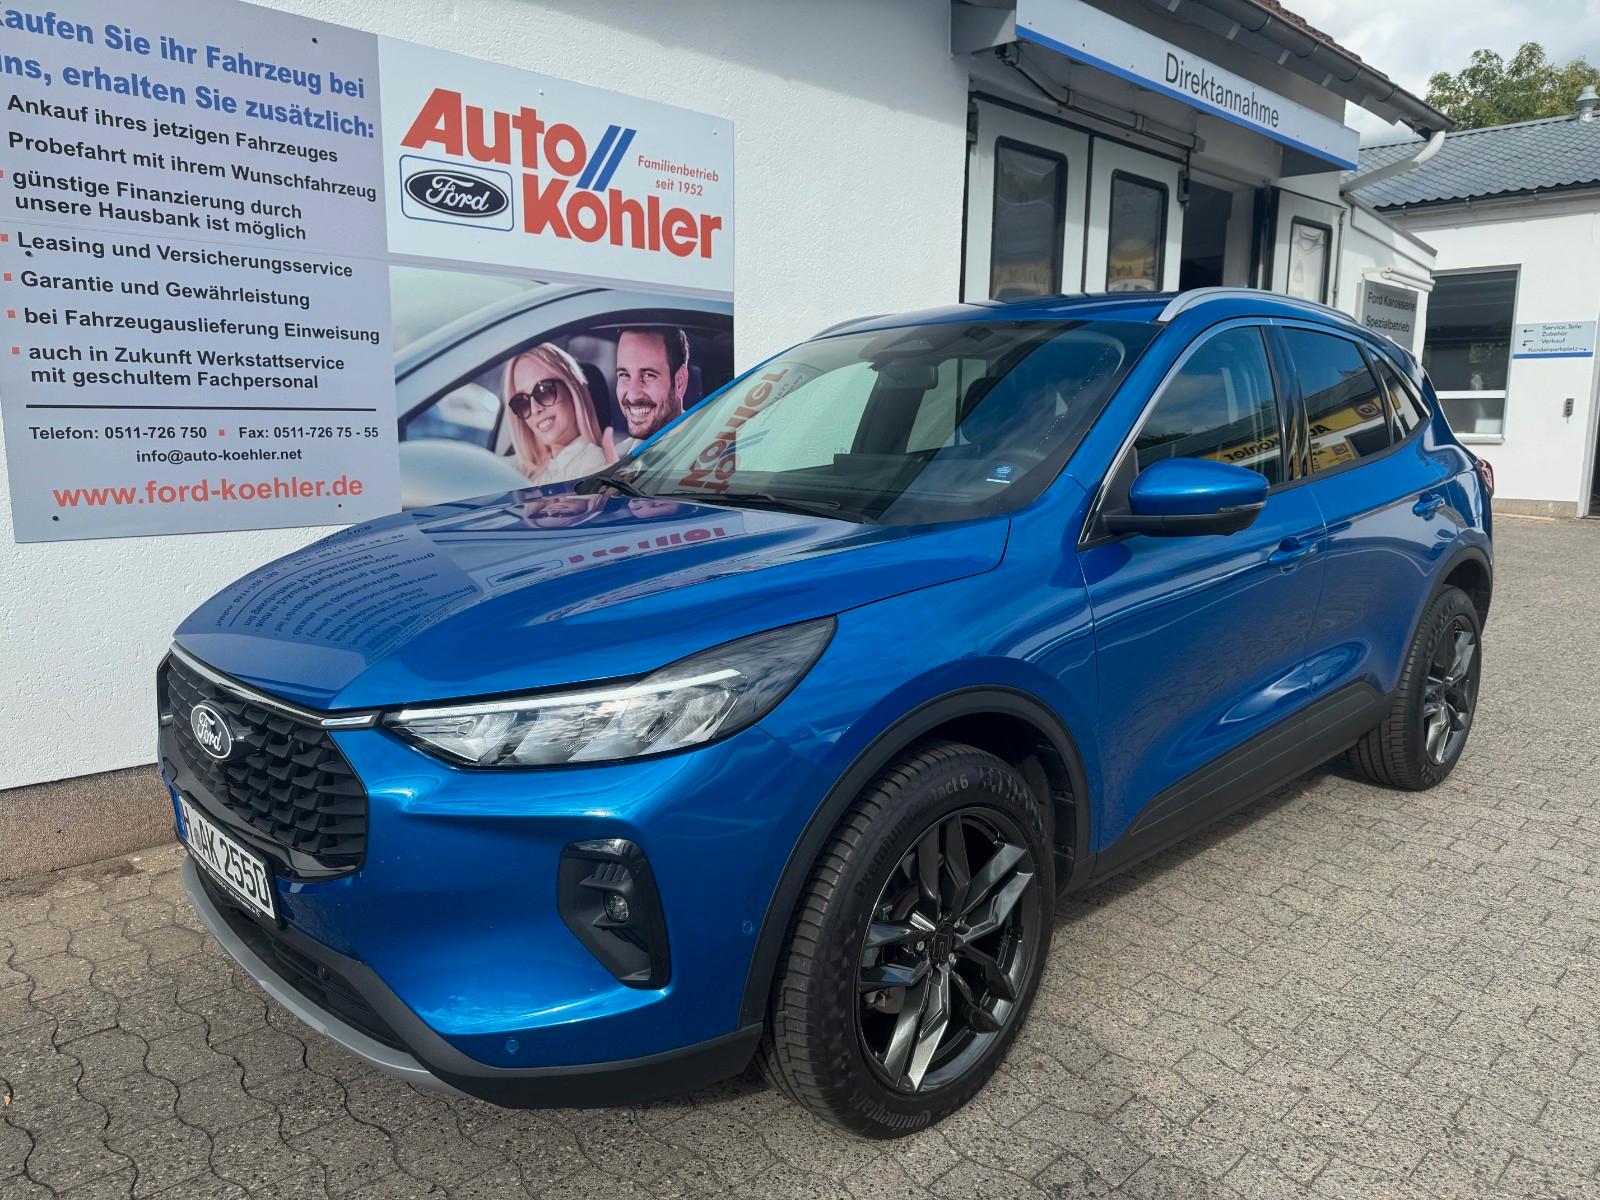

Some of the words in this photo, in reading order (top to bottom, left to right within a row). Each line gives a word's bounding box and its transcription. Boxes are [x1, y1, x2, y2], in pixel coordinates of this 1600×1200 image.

[104, 24, 150, 55] Sie
[160, 36, 197, 65] ihr
[205, 46, 321, 95] Fahrzeug
[330, 71, 364, 98] bei
[62, 66, 186, 105] erhalten
[195, 85, 237, 113] Sie
[245, 100, 374, 138] zusätzlich:
[1165, 52, 1279, 128] Direktannahme
[7, 95, 88, 123] Ankauf
[95, 109, 147, 131] ihres
[152, 119, 230, 145] jetzigen
[235, 132, 338, 162] Fahrzeuges
[400, 88, 587, 177] Auto
[8, 131, 127, 164] Probefahrt
[133, 151, 165, 169] mit
[171, 156, 226, 178] ihrem
[231, 164, 376, 201] Wunschfahrzeug
[638, 155, 720, 182] Familienbetrieb
[13, 171, 109, 197] günstige
[117, 182, 245, 214] Finanzierung
[251, 200, 302, 219] durch
[425, 174, 491, 213] Ford
[655, 178, 677, 192] seit
[678, 181, 704, 197] 1952
[15, 194, 92, 216] unsere
[99, 201, 200, 228] Hausbank
[206, 215, 229, 231] ist
[235, 220, 306, 240] möglich
[18, 231, 104, 258] Leasing
[112, 241, 151, 259] und
[156, 245, 353, 278] Versicherungsservice
[21, 271, 113, 292] Garantie
[121, 279, 159, 296] und
[166, 282, 310, 309] Gewährleistung
[24, 308, 58, 325] bei
[65, 310, 279, 339] Fahrzeugauslieferung
[284, 323, 380, 345] Einweisung
[29, 346, 82, 361] auch
[89, 345, 108, 362] in
[115, 347, 192, 365] Zukunft
[197, 351, 345, 370] Werkstattservice
[31, 367, 66, 383] mit
[73, 369, 191, 387] geschultem
[197, 372, 318, 390] Fachpersonal
[29, 426, 98, 440] Telefon:
[104, 427, 175, 440] 0511-726
[180, 427, 207, 440] 750
[239, 427, 269, 441] Fax:
[273, 426, 333, 439] 0511-726
[337, 426, 353, 439] 75
[364, 426, 379, 439] 55
[136, 449, 303, 465] info@auto-koehler.net
[53, 475, 363, 507] www.ford-koehler.de
[197, 711, 222, 752] Ford
[198, 819, 221, 871] AK
[220, 837, 271, 909] 2550
